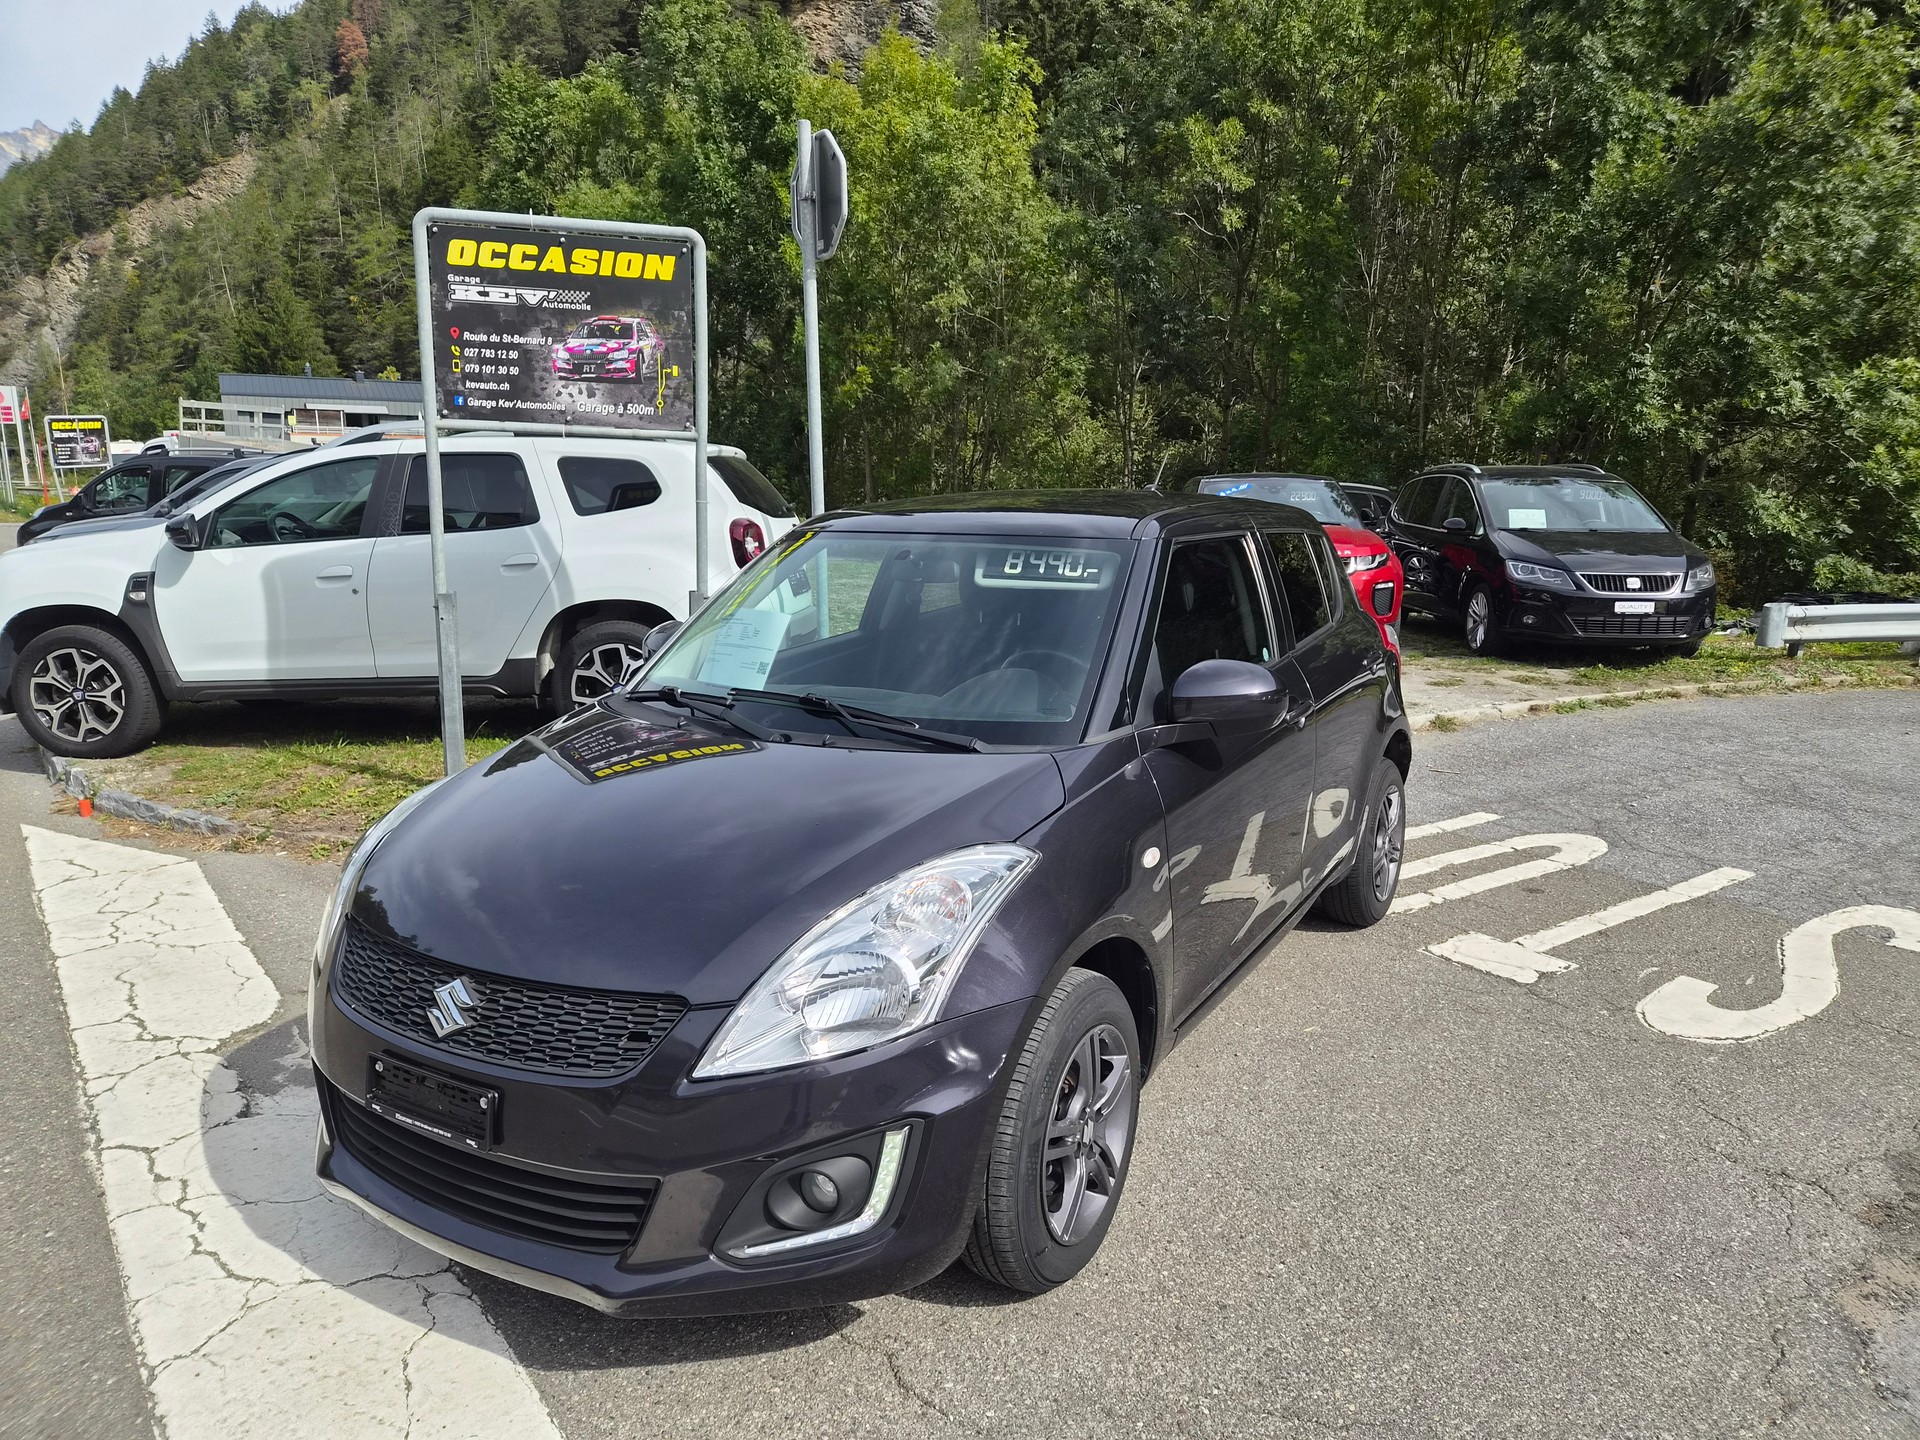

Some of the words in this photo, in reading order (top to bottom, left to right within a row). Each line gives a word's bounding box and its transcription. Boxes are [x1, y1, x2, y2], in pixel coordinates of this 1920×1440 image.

[446, 238, 676, 281] OCCASION
[447, 273, 481, 284] Garage
[542, 301, 592, 311] Automobile
[463, 331, 488, 342] Route
[489, 333, 500, 342] du
[502, 334, 546, 345] St-Bernard
[547, 337, 553, 345] 8
[464, 348, 479, 357] 027
[480, 349, 495, 358] 783
[497, 350, 507, 359] 12
[508, 350, 518, 359] 50
[464, 364, 480, 373] 079
[481, 365, 495, 374] 101
[497, 365, 508, 374] 30
[509, 366, 519, 375] 50
[583, 364, 596, 373] RT
[465, 380, 510, 391] kevauto.ch
[467, 397, 497, 409] Garage
[498, 399, 566, 411] Kev'Automobiles
[577, 401, 615, 416] Garage
[617, 402, 624, 414] à
[626, 403, 655, 416] 500m
[51, 421, 102, 430] OCCASION
